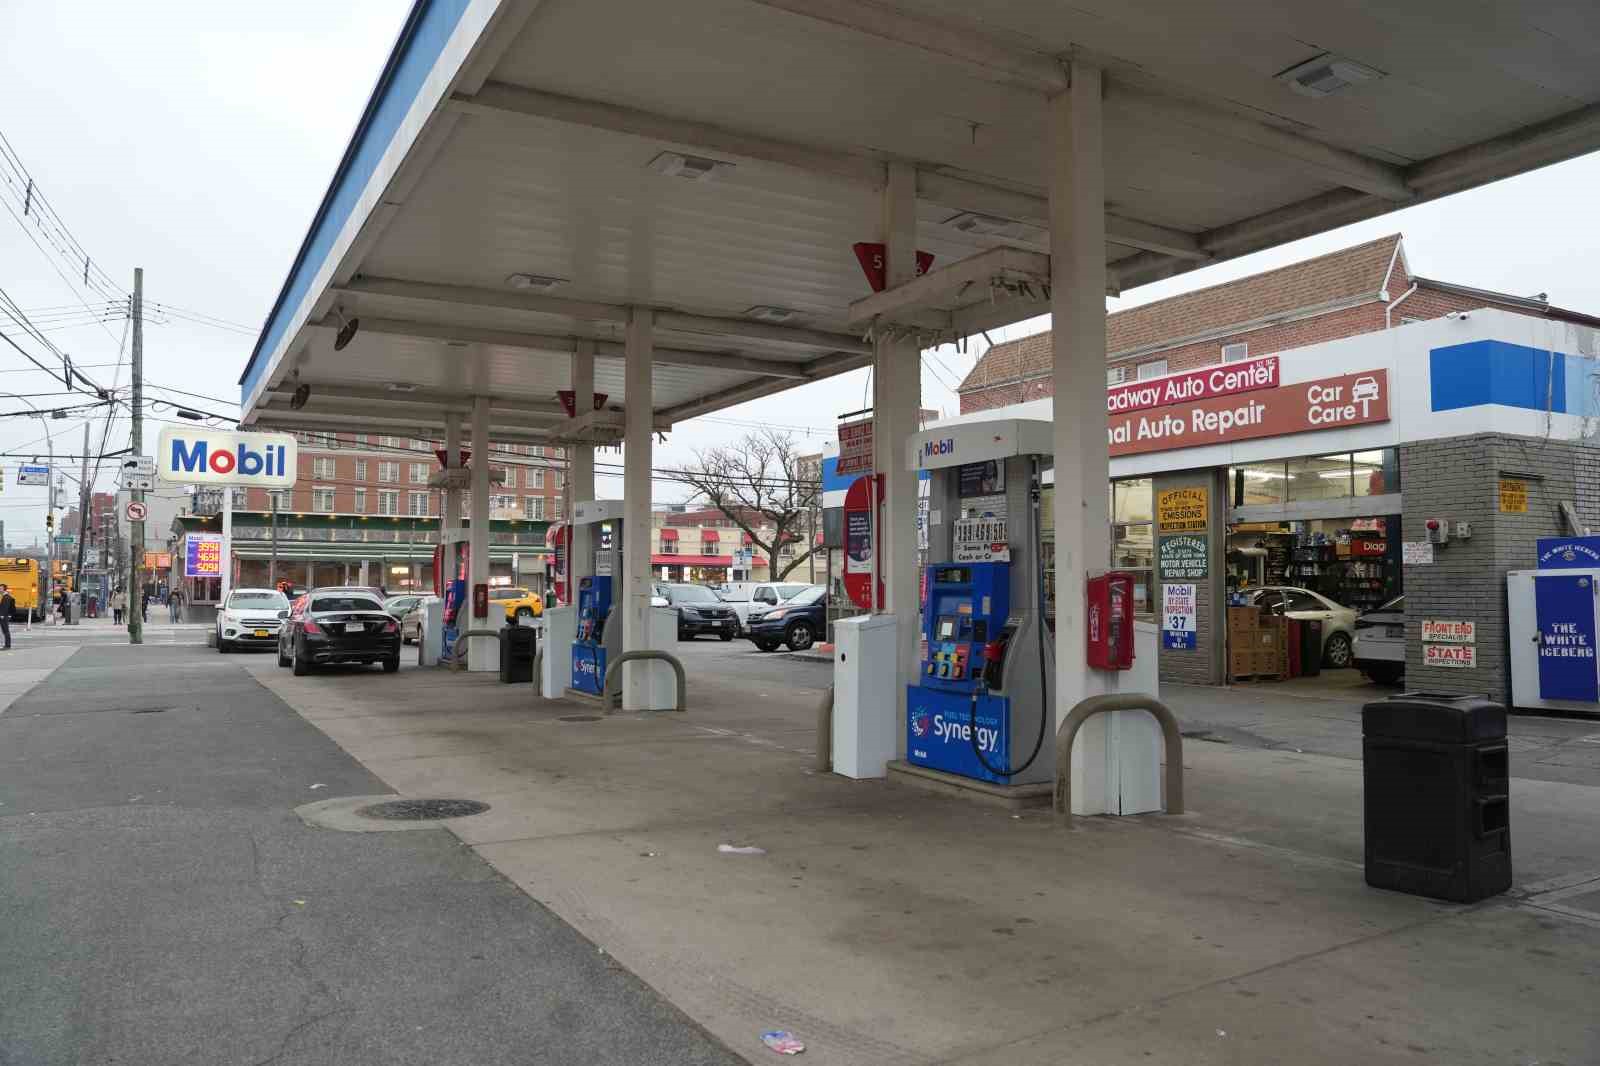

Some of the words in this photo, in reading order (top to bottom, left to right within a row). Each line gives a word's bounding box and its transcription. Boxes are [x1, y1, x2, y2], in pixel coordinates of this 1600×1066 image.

[873, 254, 883, 269] 5
[1107, 386, 1161, 411] adway
[1165, 377, 1204, 401] Auto
[1209, 364, 1275, 391] Center
[1307, 385, 1343, 404] Car
[1138, 415, 1184, 440] Auto
[1192, 400, 1265, 434] Repair
[1307, 404, 1356, 424] Care
[925, 439, 953, 456] Mobil
[171, 439, 285, 476] Mobil
[200, 494, 248, 505] DINR
[1162, 489, 1203, 504] OFFICIAL
[1162, 510, 1202, 520] EMISSIONS
[1161, 536, 1206, 552] REGISTERED
[1161, 560, 1180, 568] MOTOR
[1181, 559, 1207, 568] VEHICLE
[1164, 568, 1185, 577] REPAIR
[1187, 568, 1203, 576] SHOP
[1168, 585, 1191, 596] Mobil
[1165, 605, 1193, 615] INSPECTION
[1168, 616, 1186, 629] $37
[1424, 623, 1452, 634] FRONT
[1455, 623, 1472, 634] END
[1552, 623, 1577, 634] THE
[1544, 635, 1588, 646] WHITE
[1427, 647, 1472, 659] STATE
[1541, 646, 1594, 658] ICEBERG
